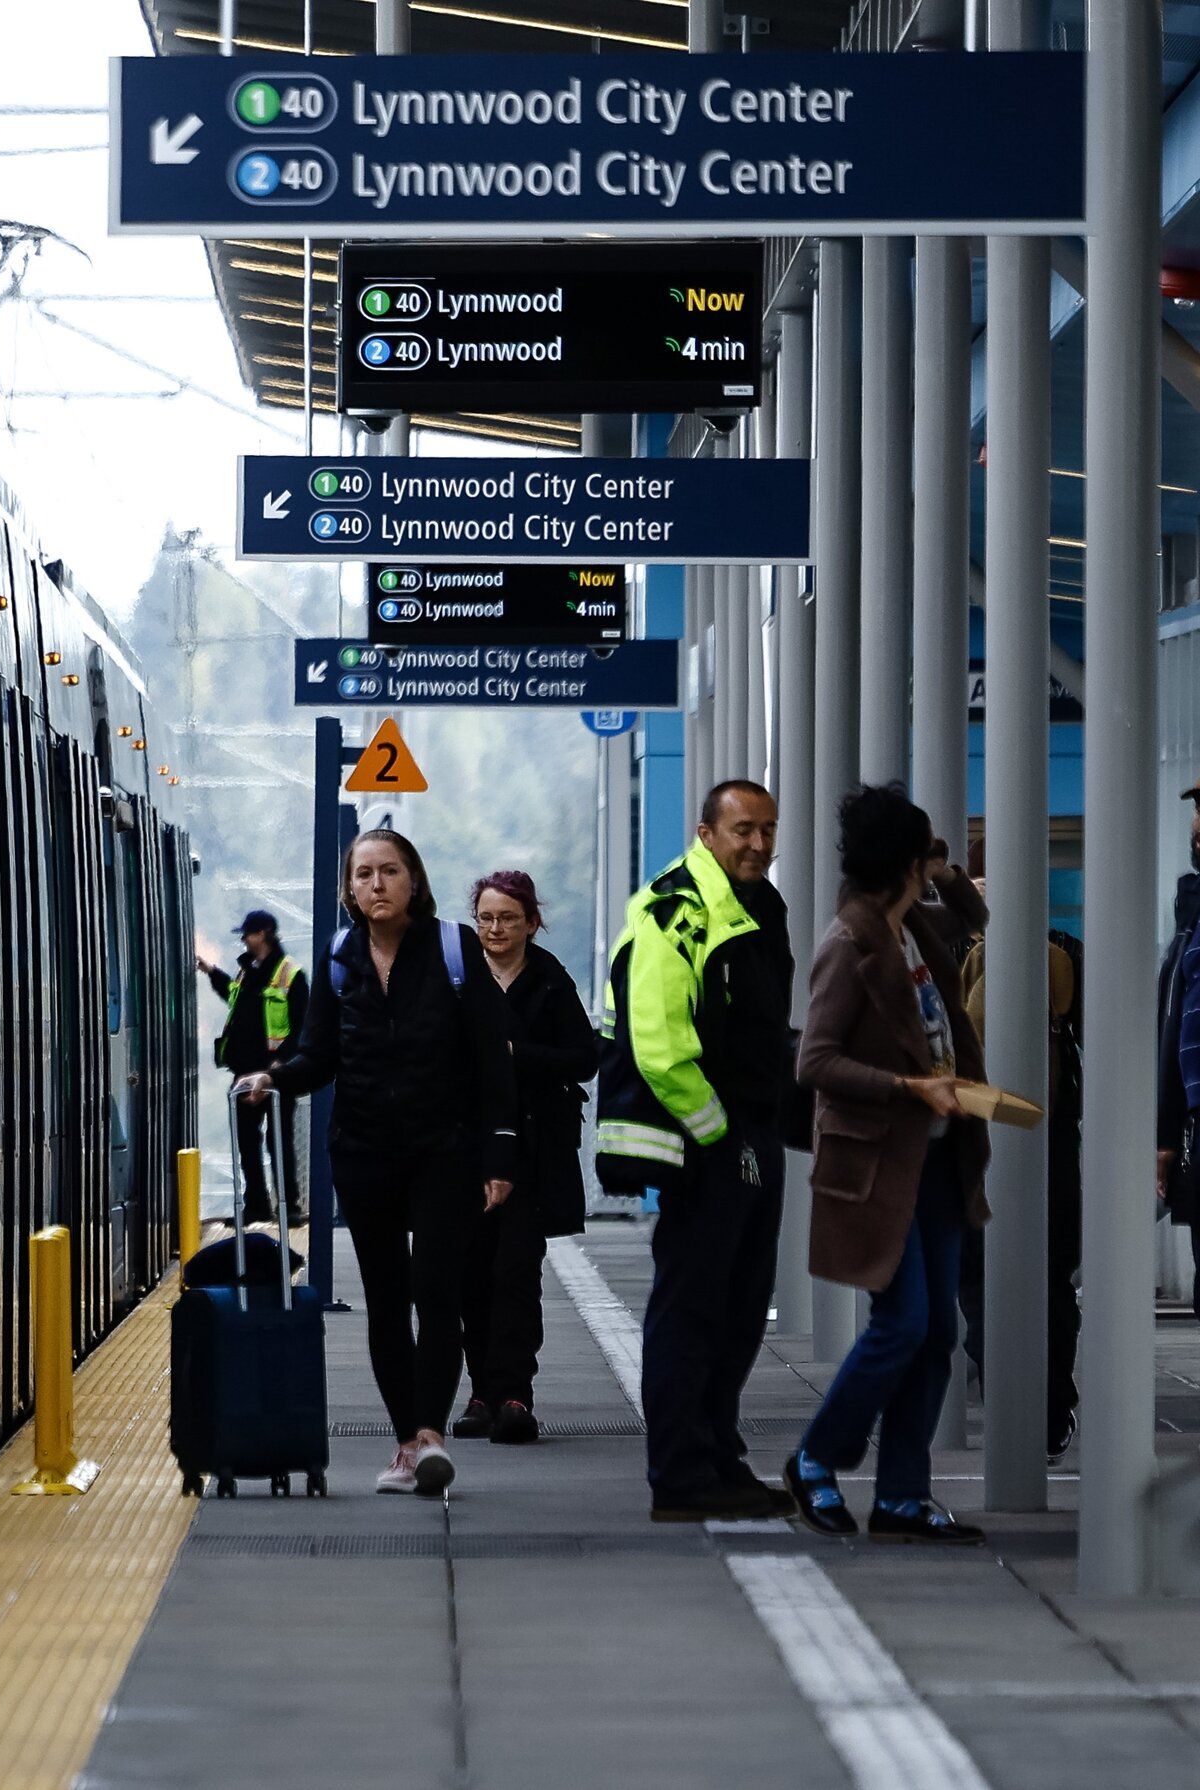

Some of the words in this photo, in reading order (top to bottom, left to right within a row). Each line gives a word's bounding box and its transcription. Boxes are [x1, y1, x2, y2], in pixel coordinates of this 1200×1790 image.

[250, 88, 265, 118] 1
[282, 88, 323, 118] 40
[353, 79, 581, 136] Lynnwood
[599, 80, 687, 136] City
[702, 80, 854, 124] Center
[250, 160, 269, 190] 2
[282, 160, 322, 190] 40
[353, 151, 581, 208] Lynnwood
[598, 152, 687, 208] City
[701, 152, 853, 195] Center
[371, 293, 382, 312] 1
[396, 293, 421, 312] 40
[438, 288, 563, 320] Lynnwood
[687, 288, 745, 312] Now
[371, 342, 383, 360] 2
[396, 342, 421, 361] 40
[438, 336, 562, 369] Lynnwood
[321, 475, 330, 493] 1
[340, 475, 363, 493] 40
[382, 471, 515, 505] Lynnwood
[525, 472, 577, 505] City
[585, 473, 674, 499] Center
[320, 517, 332, 535] 2
[339, 517, 363, 535] 40
[382, 514, 514, 546] Lynnwood
[524, 514, 576, 548] City
[584, 515, 674, 541] Center
[400, 574, 417, 588] 40
[426, 571, 504, 592] Lynnwood
[579, 571, 616, 587] Now
[385, 604, 394, 617] 2
[400, 603, 417, 617] 40
[425, 601, 504, 622] Lynnwood
[361, 651, 377, 665] 40
[387, 649, 480, 673] Lynnwood
[484, 649, 521, 674] City
[526, 649, 588, 669] Center
[347, 680, 356, 694] 2
[360, 680, 377, 694] 40
[387, 677, 480, 701] Lynnwood
[484, 678, 520, 701] City
[525, 678, 587, 697] Center
[376, 742, 399, 782] 2
